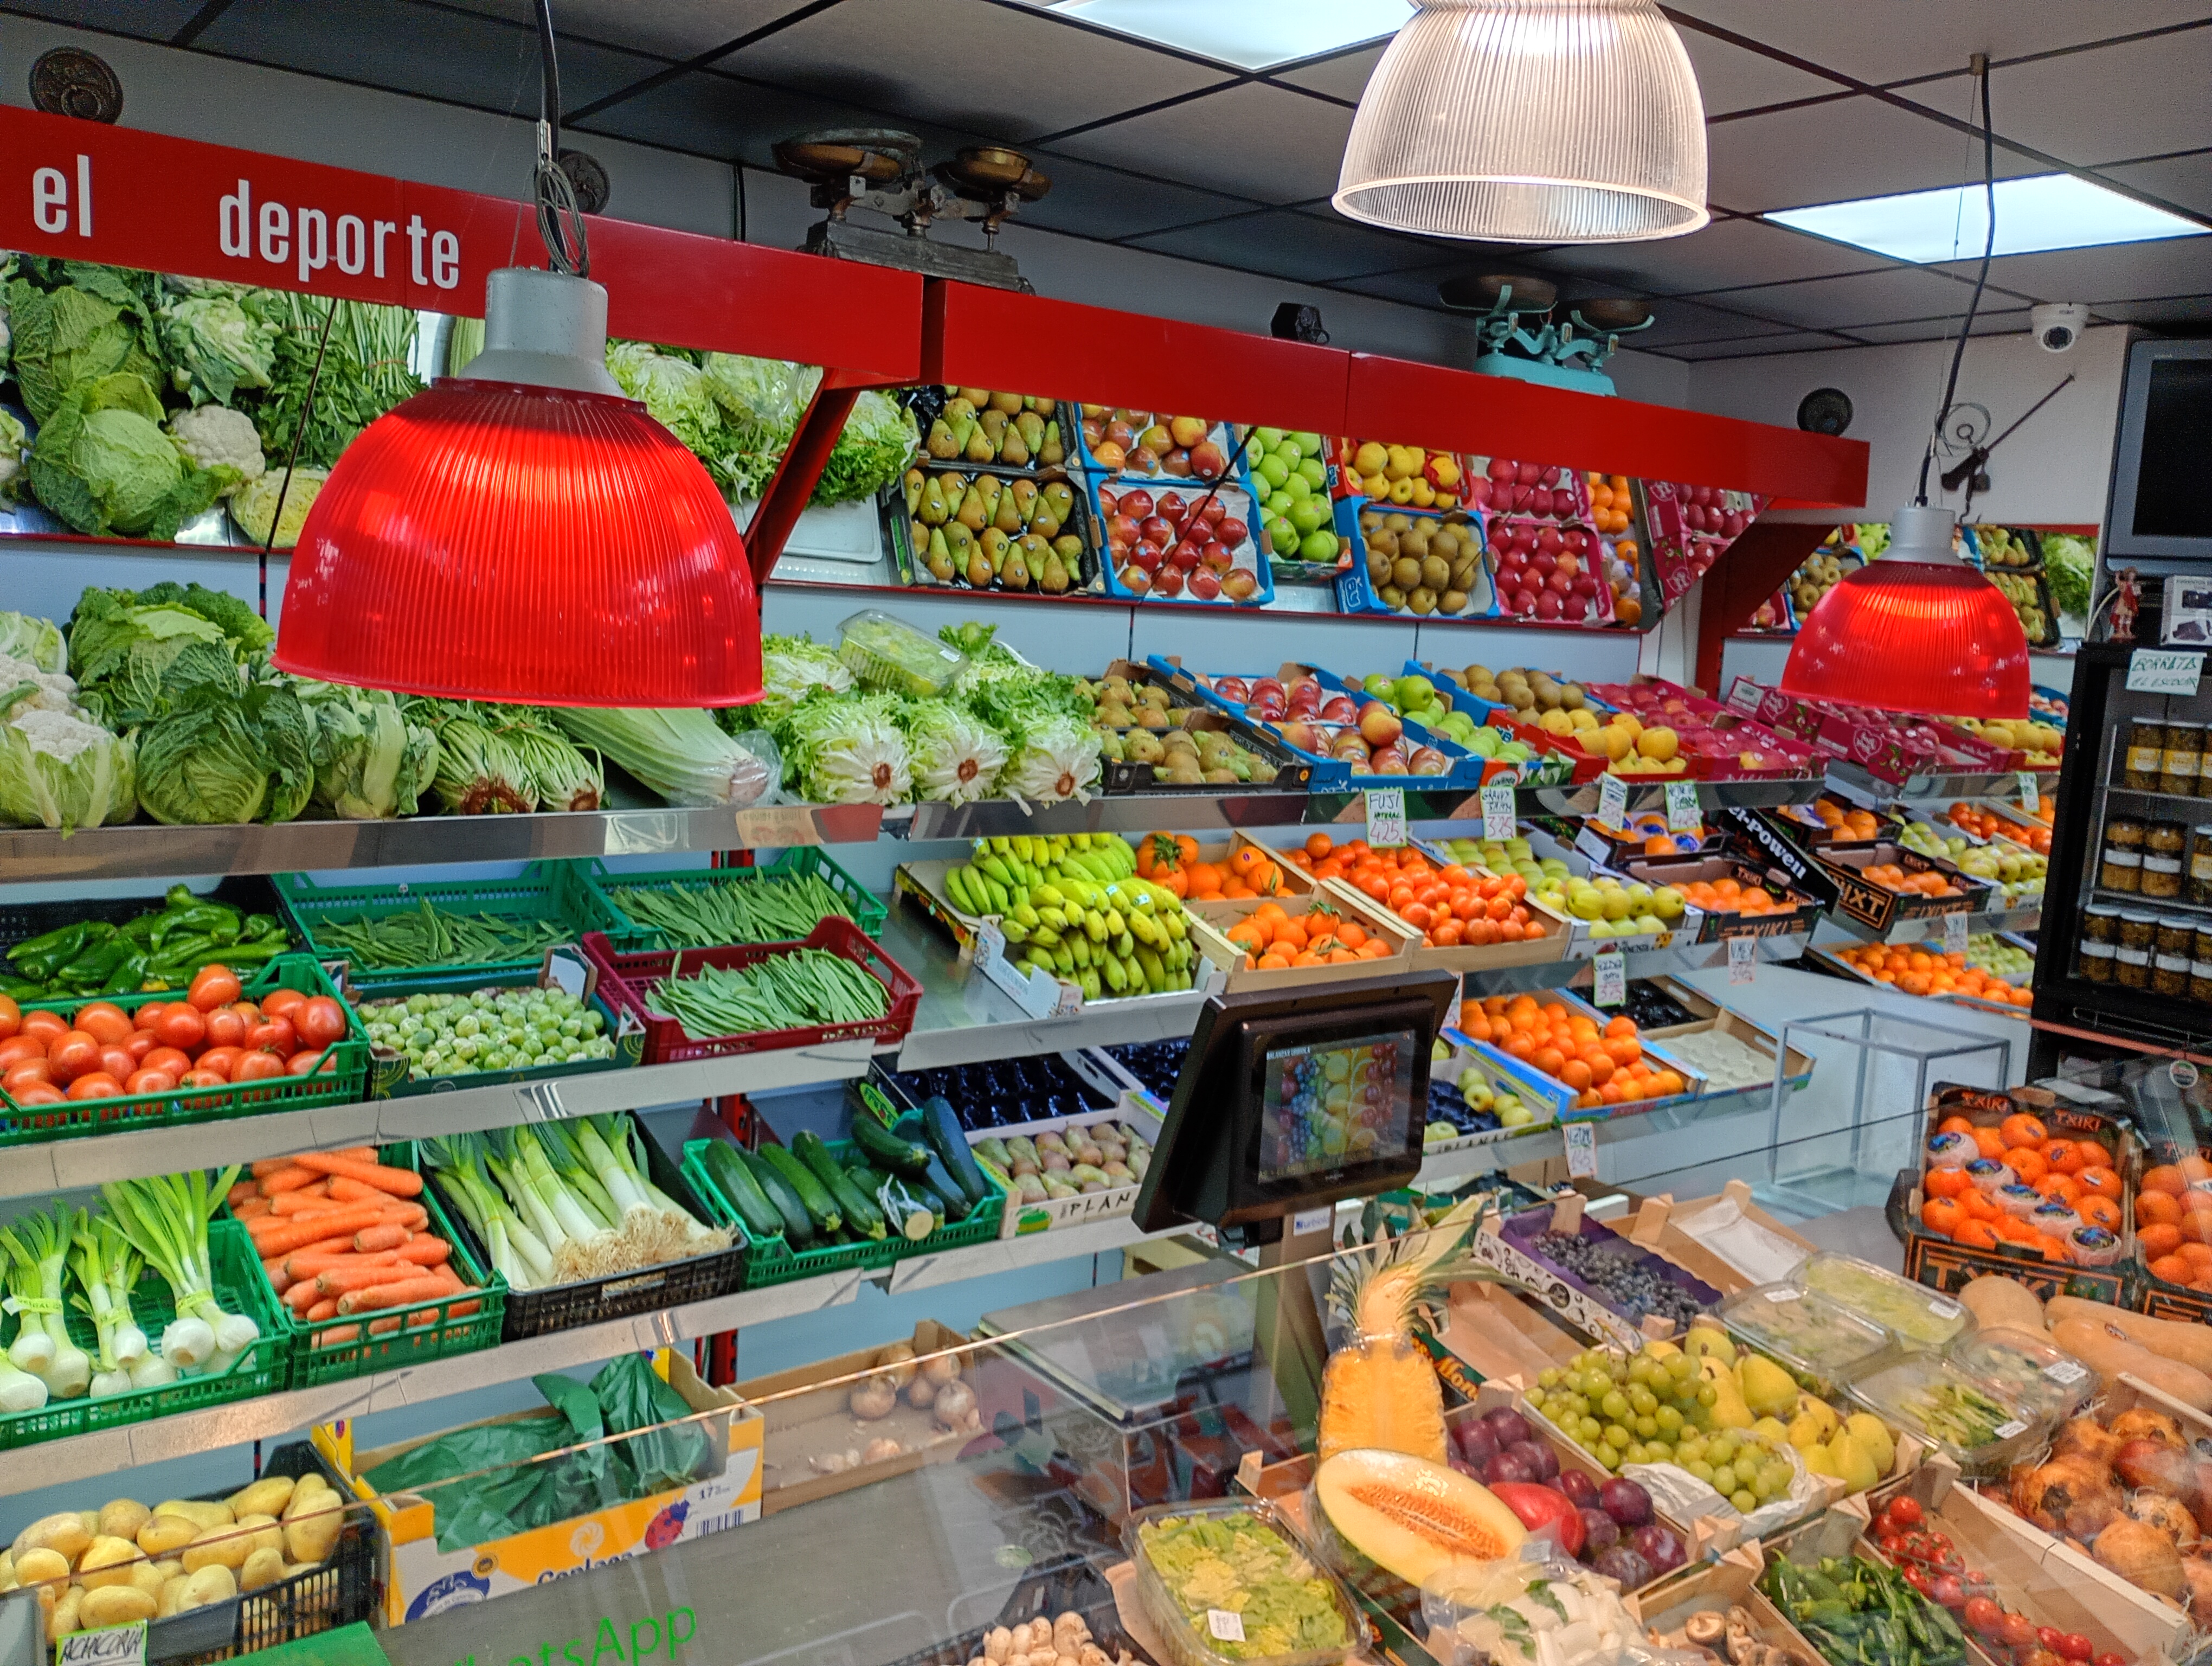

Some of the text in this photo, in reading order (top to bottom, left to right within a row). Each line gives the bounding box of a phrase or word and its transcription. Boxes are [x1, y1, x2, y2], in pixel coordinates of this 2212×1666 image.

[33, 154, 459, 290] el deporte
[1369, 791, 1401, 810] FUJI
[2055, 1108, 2101, 1132] TXIKI
[454, 1606, 697, 1666] tsApp
